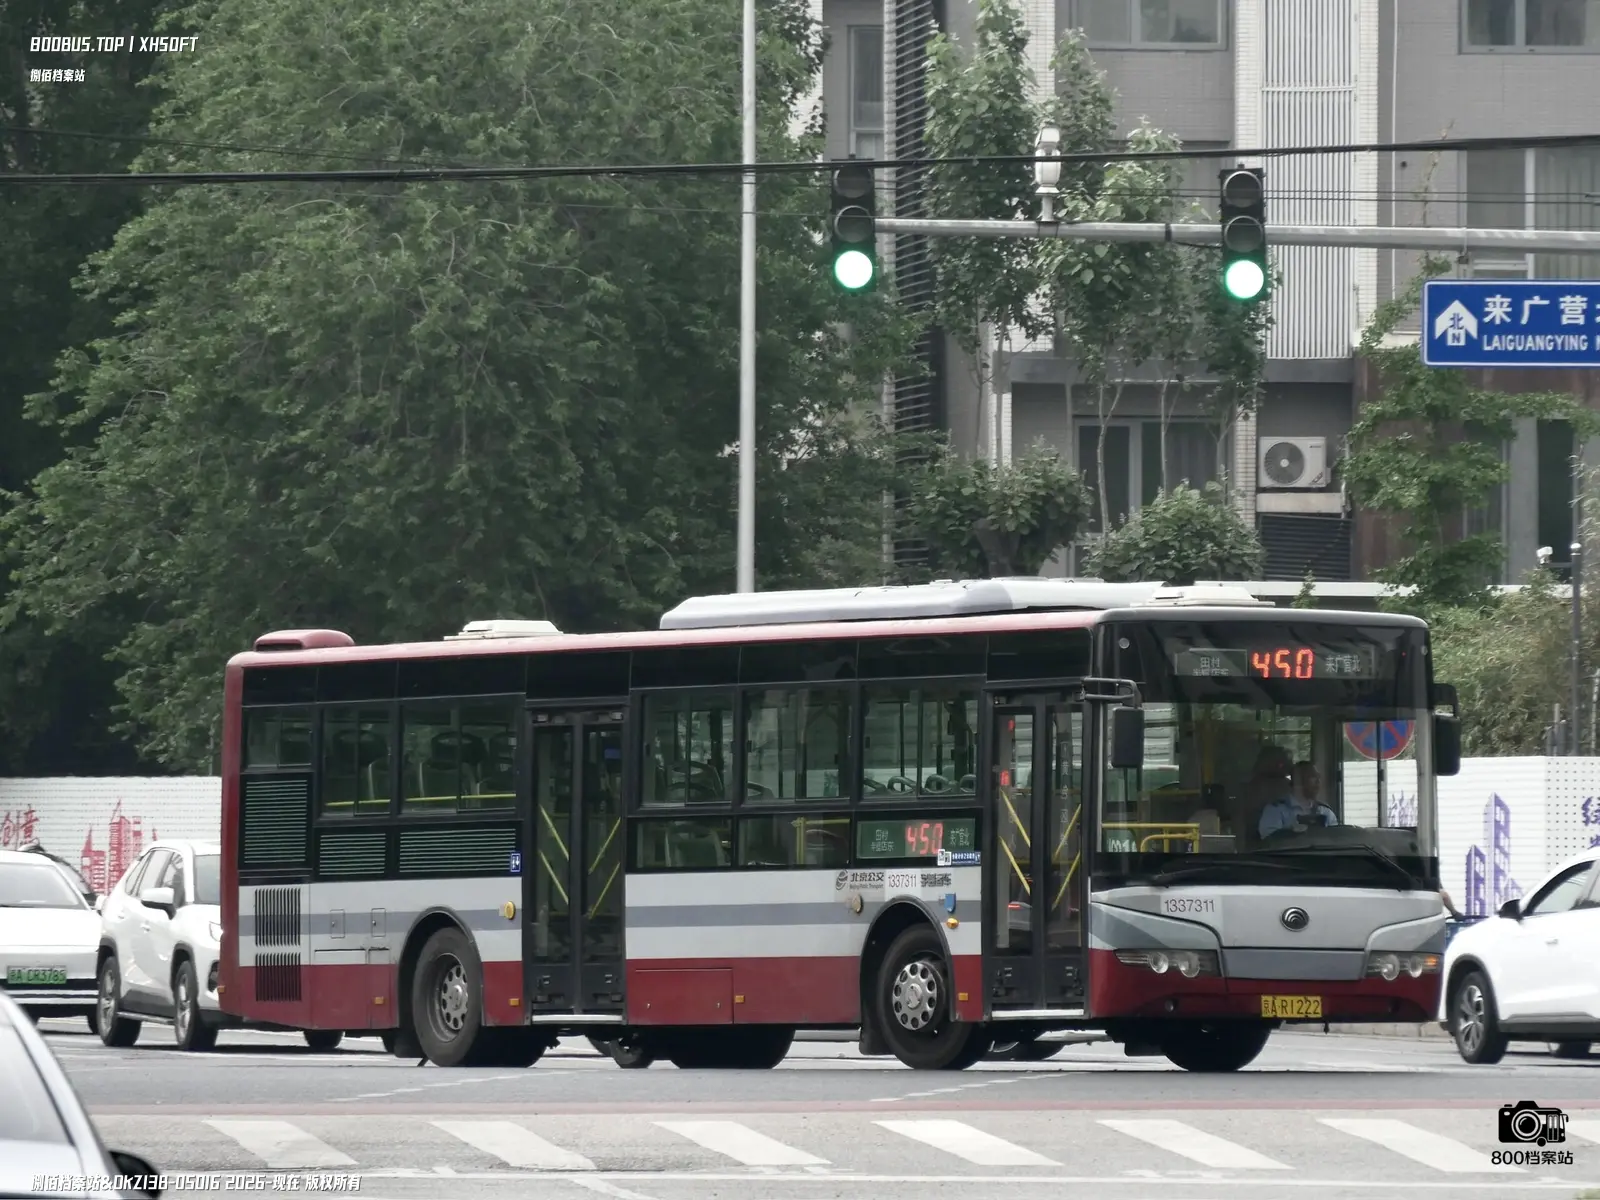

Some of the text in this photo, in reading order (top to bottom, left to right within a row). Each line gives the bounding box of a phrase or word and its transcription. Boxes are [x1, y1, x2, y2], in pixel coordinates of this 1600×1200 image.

[1482, 294, 1600, 325] 来广营
[1448, 312, 1464, 330] 北
[1451, 332, 1461, 344] N
[1482, 334, 1588, 351] LAIGUANGYING
[1252, 648, 1314, 679] 450
[906, 823, 944, 855] 450
[850, 871, 885, 883] 北京公交
[887, 874, 917, 888] 1337311
[1164, 898, 1215, 913] 1337311
